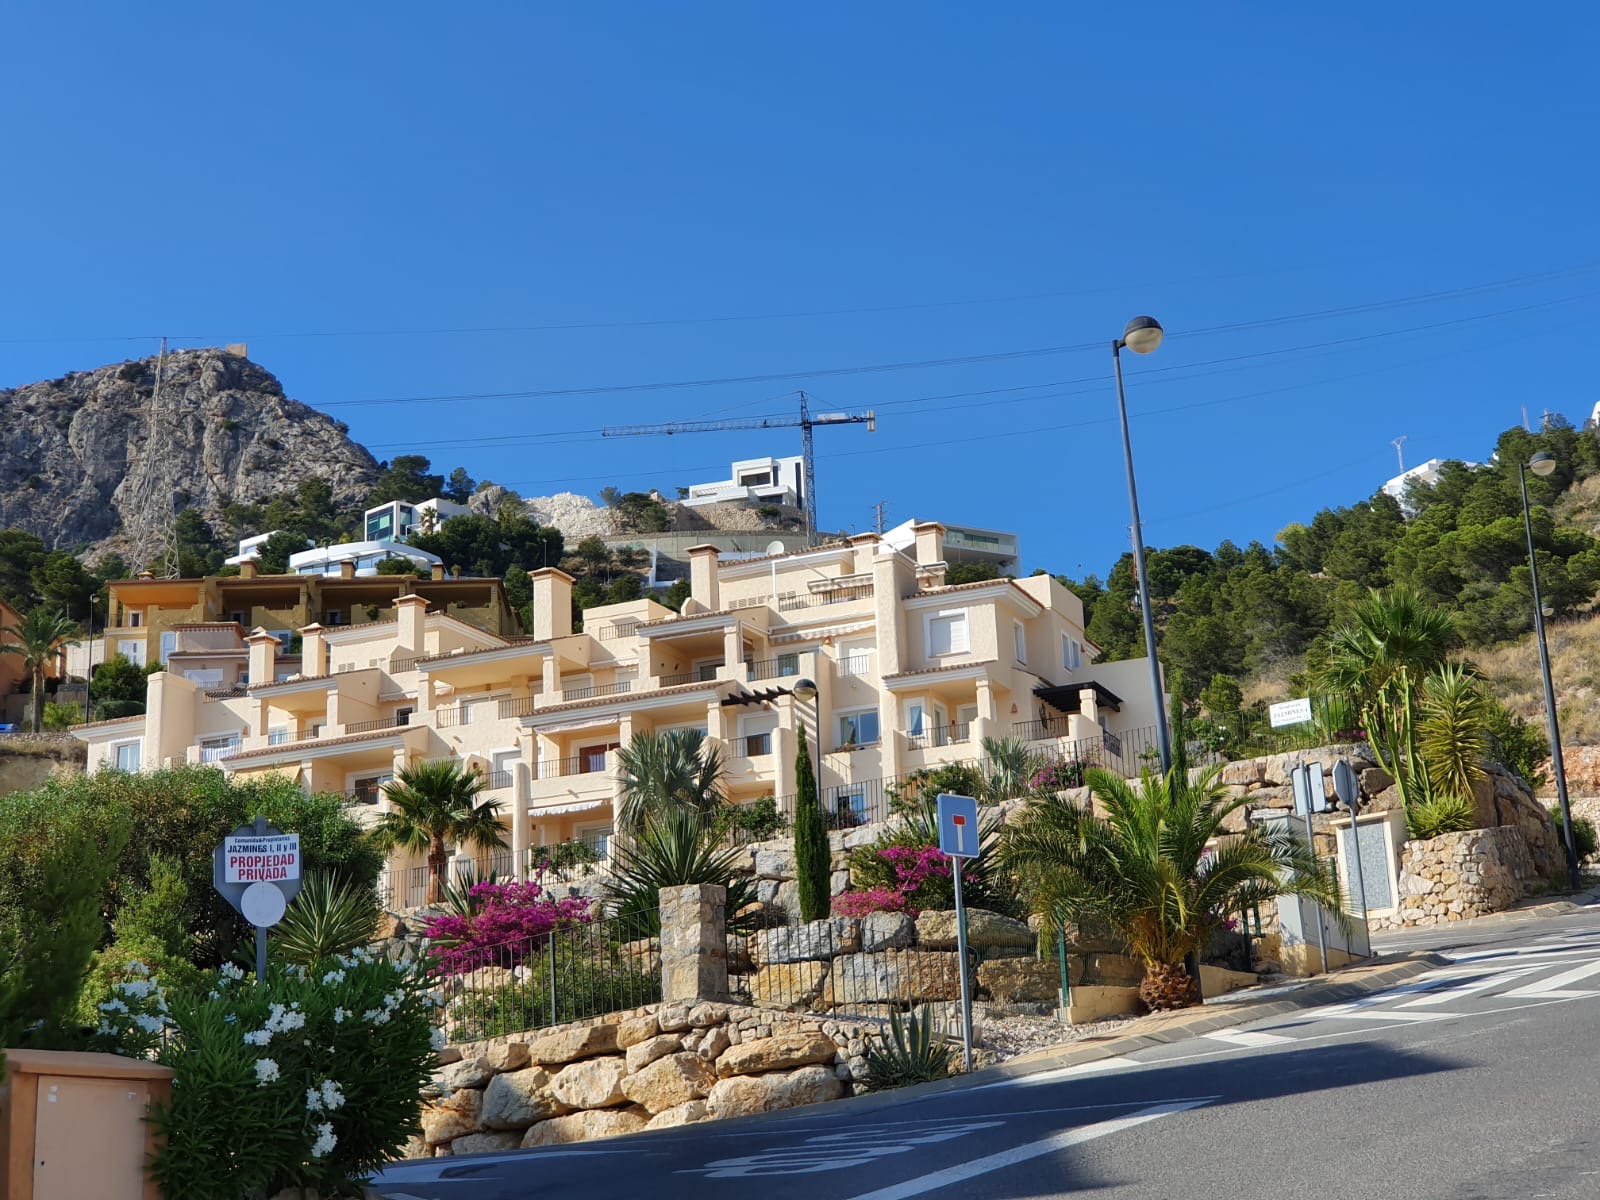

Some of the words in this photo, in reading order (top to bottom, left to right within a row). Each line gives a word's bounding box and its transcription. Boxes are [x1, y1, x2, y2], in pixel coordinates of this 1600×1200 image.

[228, 844, 267, 853] JAZMINES
[230, 853, 294, 868] PROPIEDAD
[238, 867, 287, 880] PRIVADA
